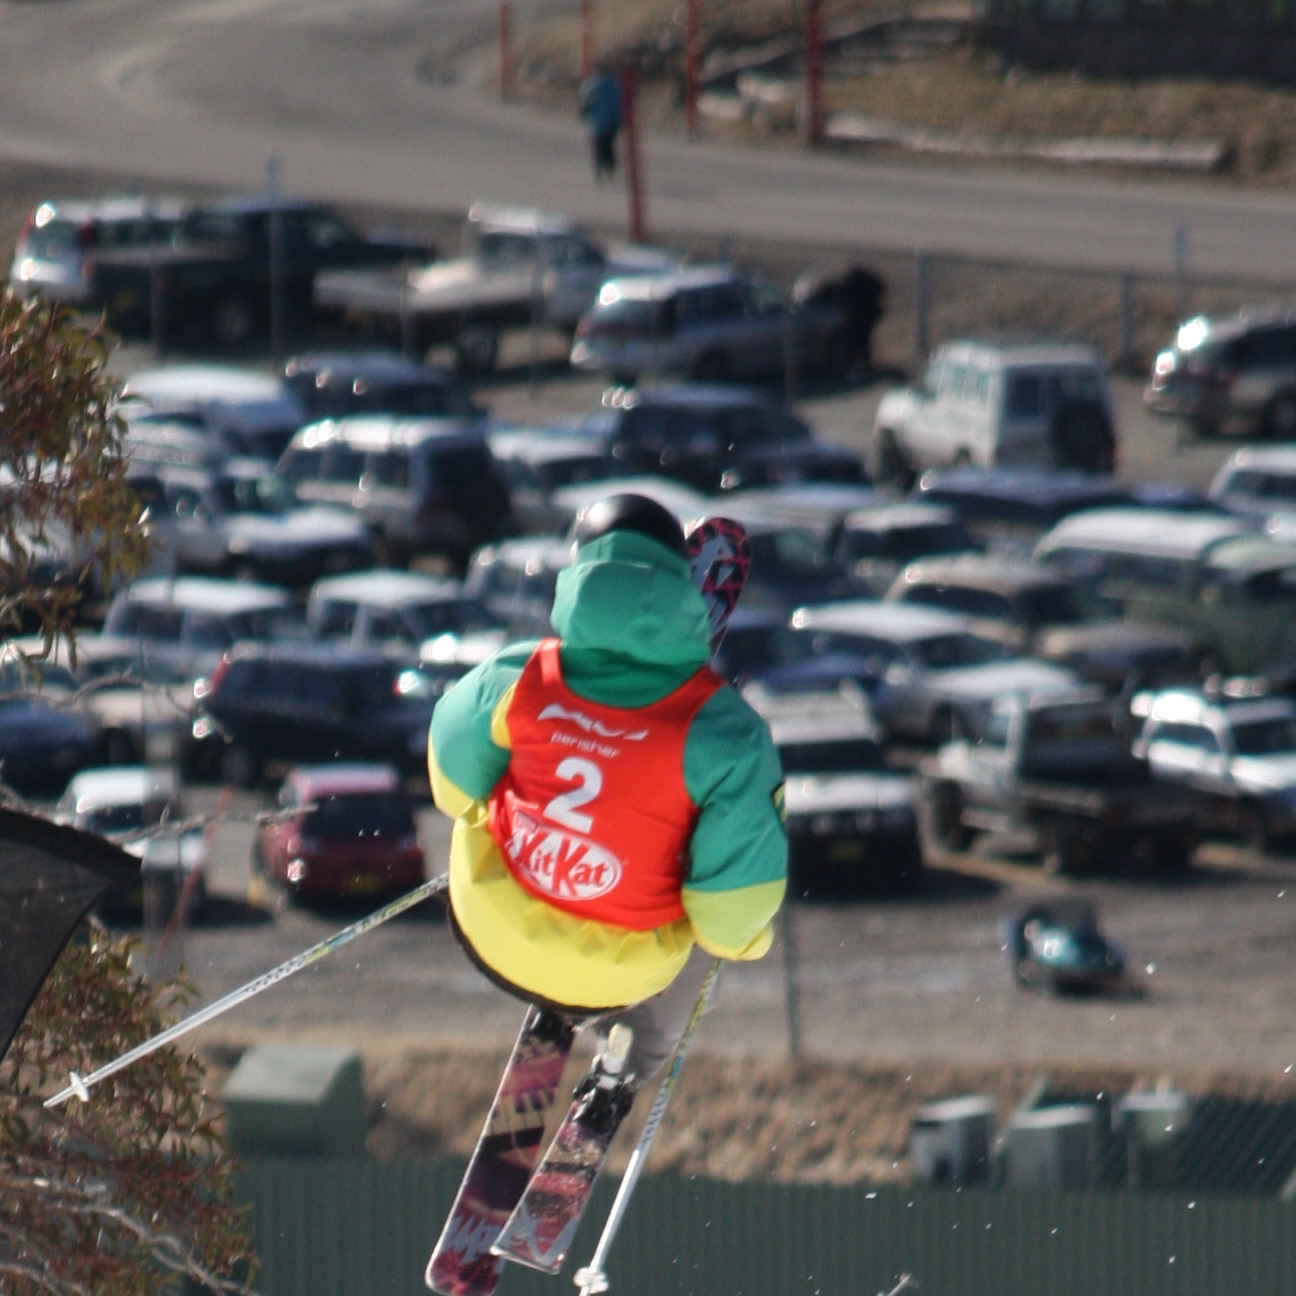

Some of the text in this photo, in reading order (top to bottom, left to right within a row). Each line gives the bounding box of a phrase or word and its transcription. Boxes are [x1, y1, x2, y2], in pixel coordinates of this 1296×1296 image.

[550, 731, 621, 759] perisher
[542, 756, 603, 835] 2
[516, 830, 609, 897] KitKat
